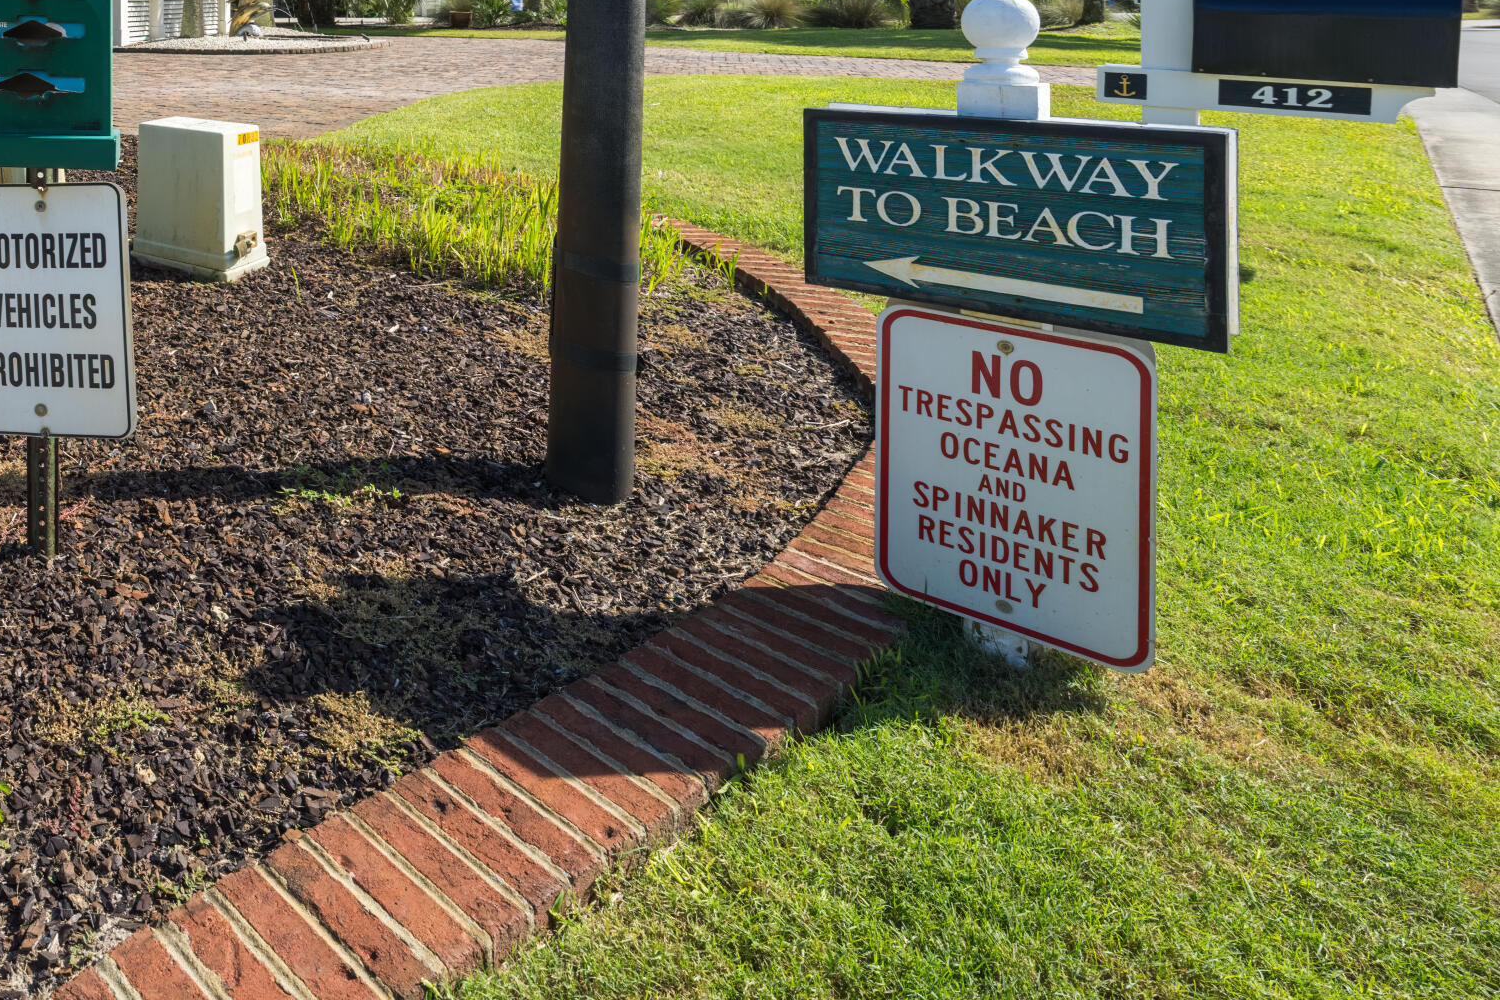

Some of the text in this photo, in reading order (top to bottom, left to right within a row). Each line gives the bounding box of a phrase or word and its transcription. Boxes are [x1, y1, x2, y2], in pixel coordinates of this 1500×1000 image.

[1250, 85, 1334, 110] 412
[833, 136, 1179, 201] WALKWAY
[836, 185, 1174, 260] TO BEACH
[971, 350, 1044, 407] NO
[898, 384, 1130, 464] TRESPASSING
[940, 431, 1076, 491] OCEANA
[977, 474, 1027, 503] AND
[912, 480, 1107, 561] SPINNAKER
[918, 514, 1100, 593] RESIDENTS
[959, 559, 1047, 609] ONLY
